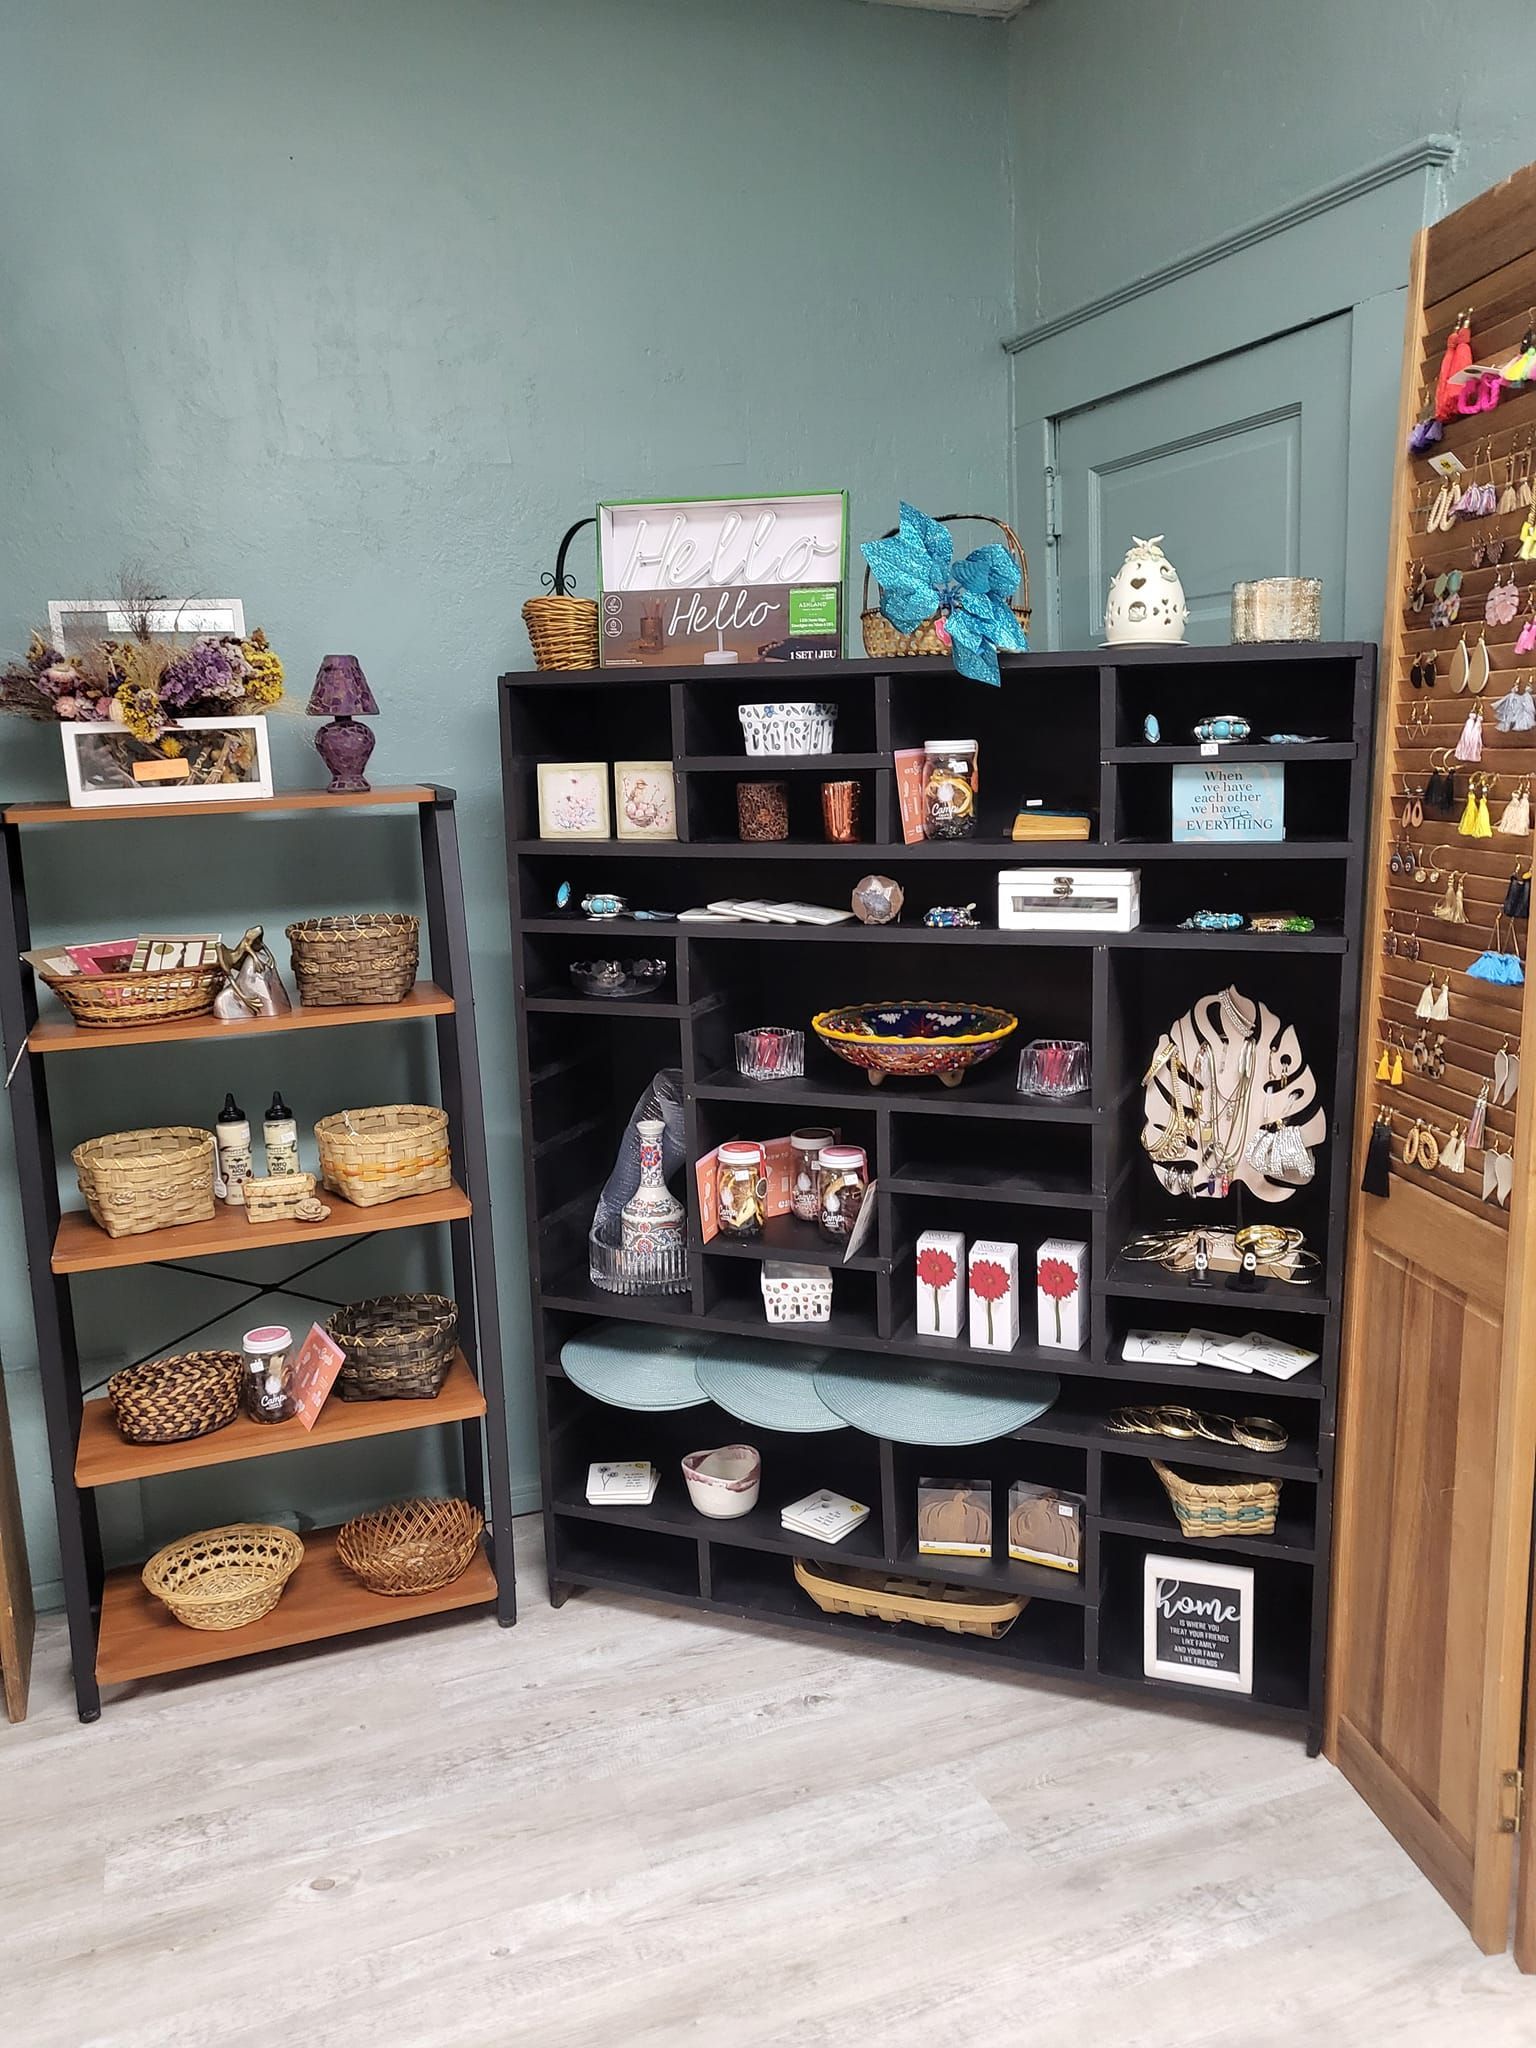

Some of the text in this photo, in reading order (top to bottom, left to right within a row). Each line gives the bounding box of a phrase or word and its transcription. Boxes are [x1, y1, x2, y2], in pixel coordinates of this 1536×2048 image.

[619, 510, 838, 592] Hello
[668, 589, 780, 637] Hello
[795, 650, 814, 660] SET
[818, 649, 838, 659] JEU
[1204, 770, 1243, 781] When
[1202, 781, 1253, 793] we have
[1194, 791, 1262, 803] each other
[1191, 803, 1241, 814] we have
[1186, 814, 1274, 831] EVERYTHING
[228, 1162, 248, 1170] TRUFFLE
[260, 1394, 288, 1409] Camp
[1156, 1579, 1240, 1623] home
[1179, 1619, 1220, 1632] IS WHERE YOU
[1170, 1626, 1230, 1643] TREAT YOUR FRIENDS
[1181, 1637, 1217, 1650] LIKE FAMILY
[1174, 1645, 1225, 1660] AND YOUR FAMILY
[1180, 1655, 1218, 1668] LIKE FRIENDS
